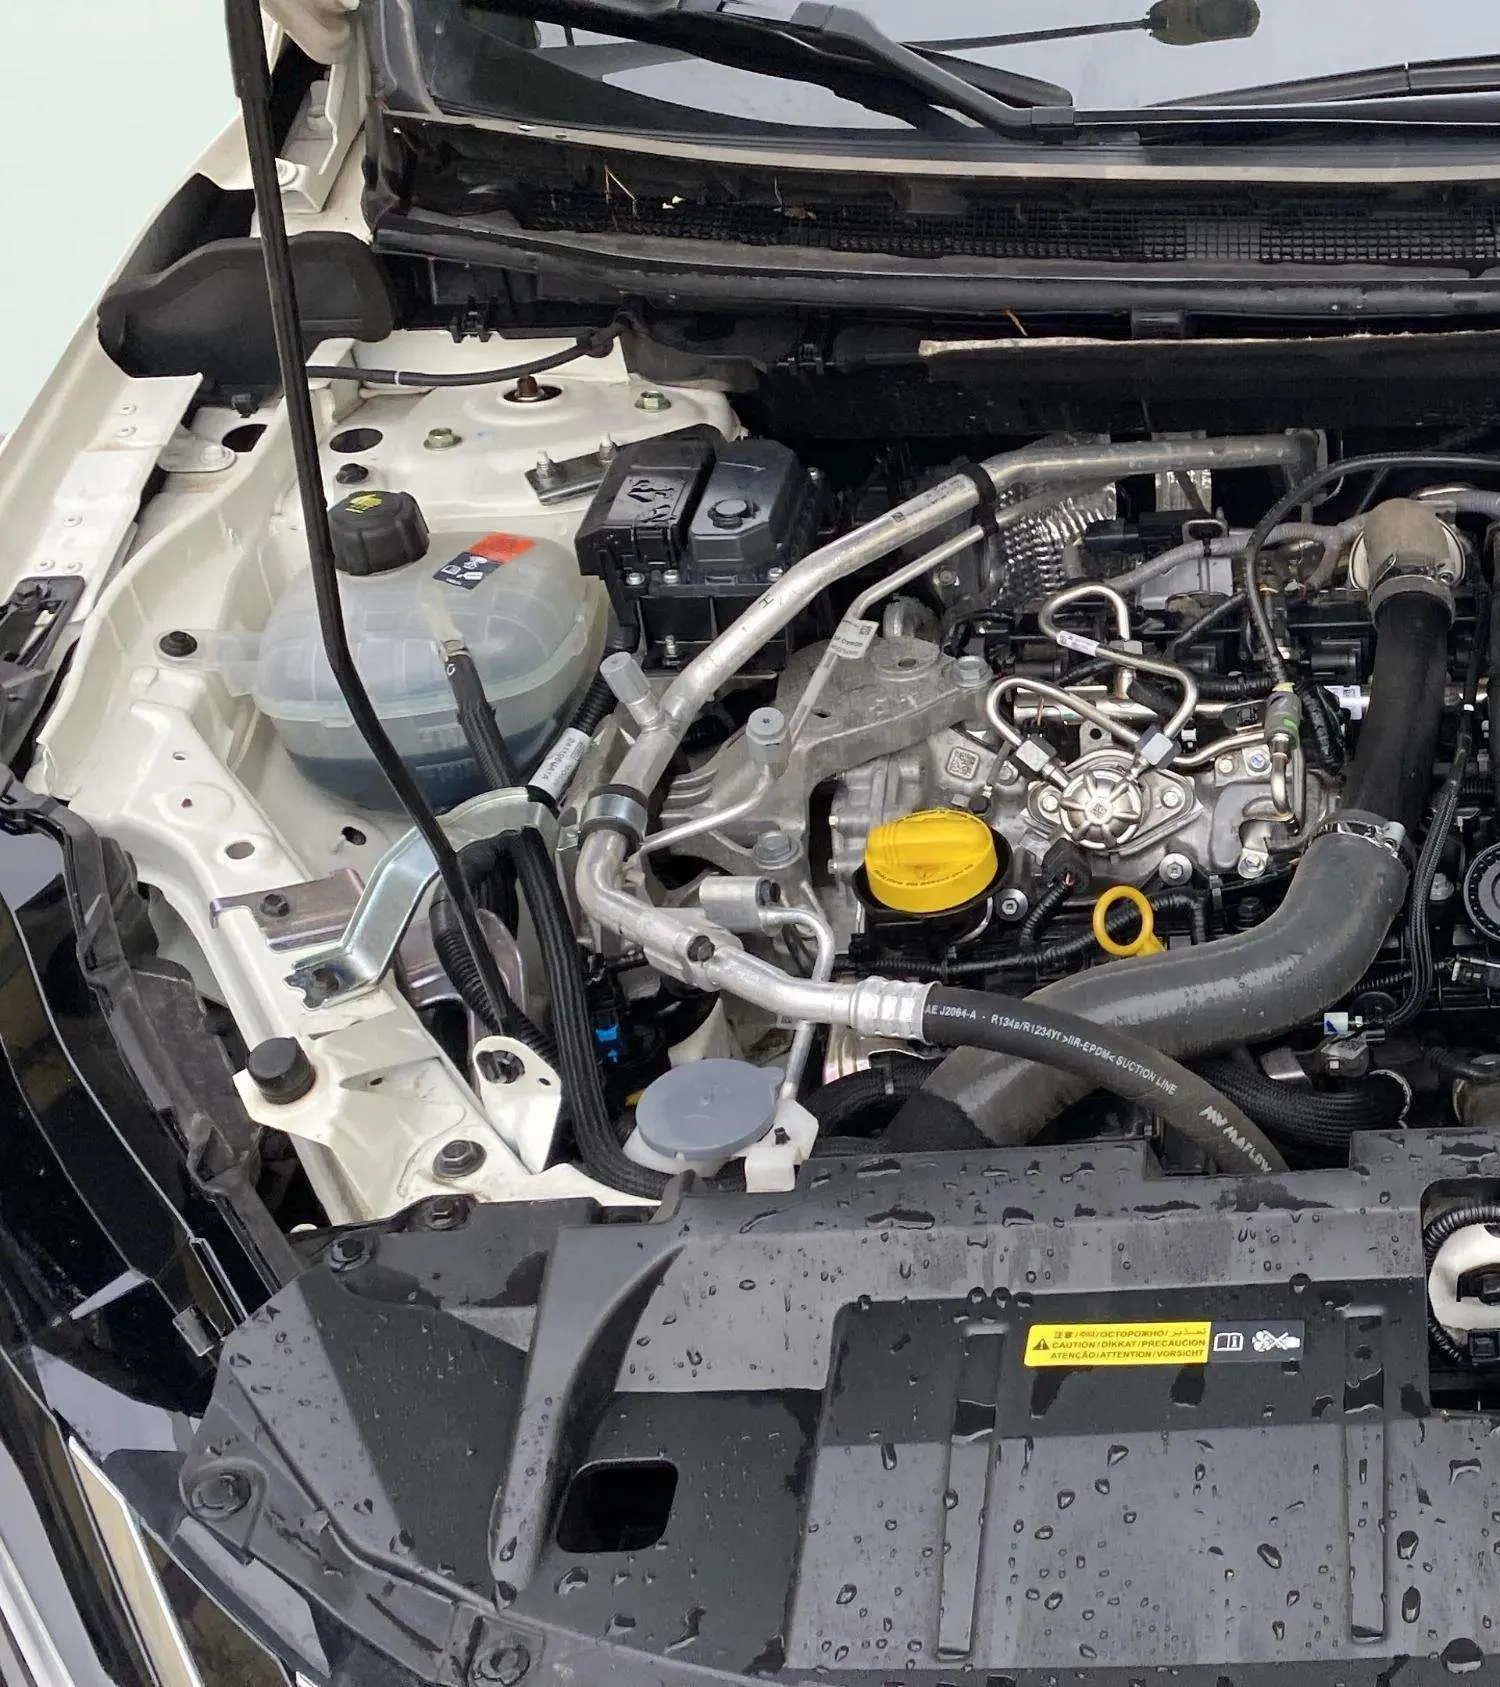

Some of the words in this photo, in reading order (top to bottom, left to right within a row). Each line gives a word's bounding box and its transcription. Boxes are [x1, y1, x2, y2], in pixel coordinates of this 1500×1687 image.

[939, 1005, 976, 1020] J2064-A
[1116, 1056, 1155, 1083] SUCTION
[1156, 1077, 1179, 1096] LINE
[1223, 1126, 1272, 1172] MAFLOW
